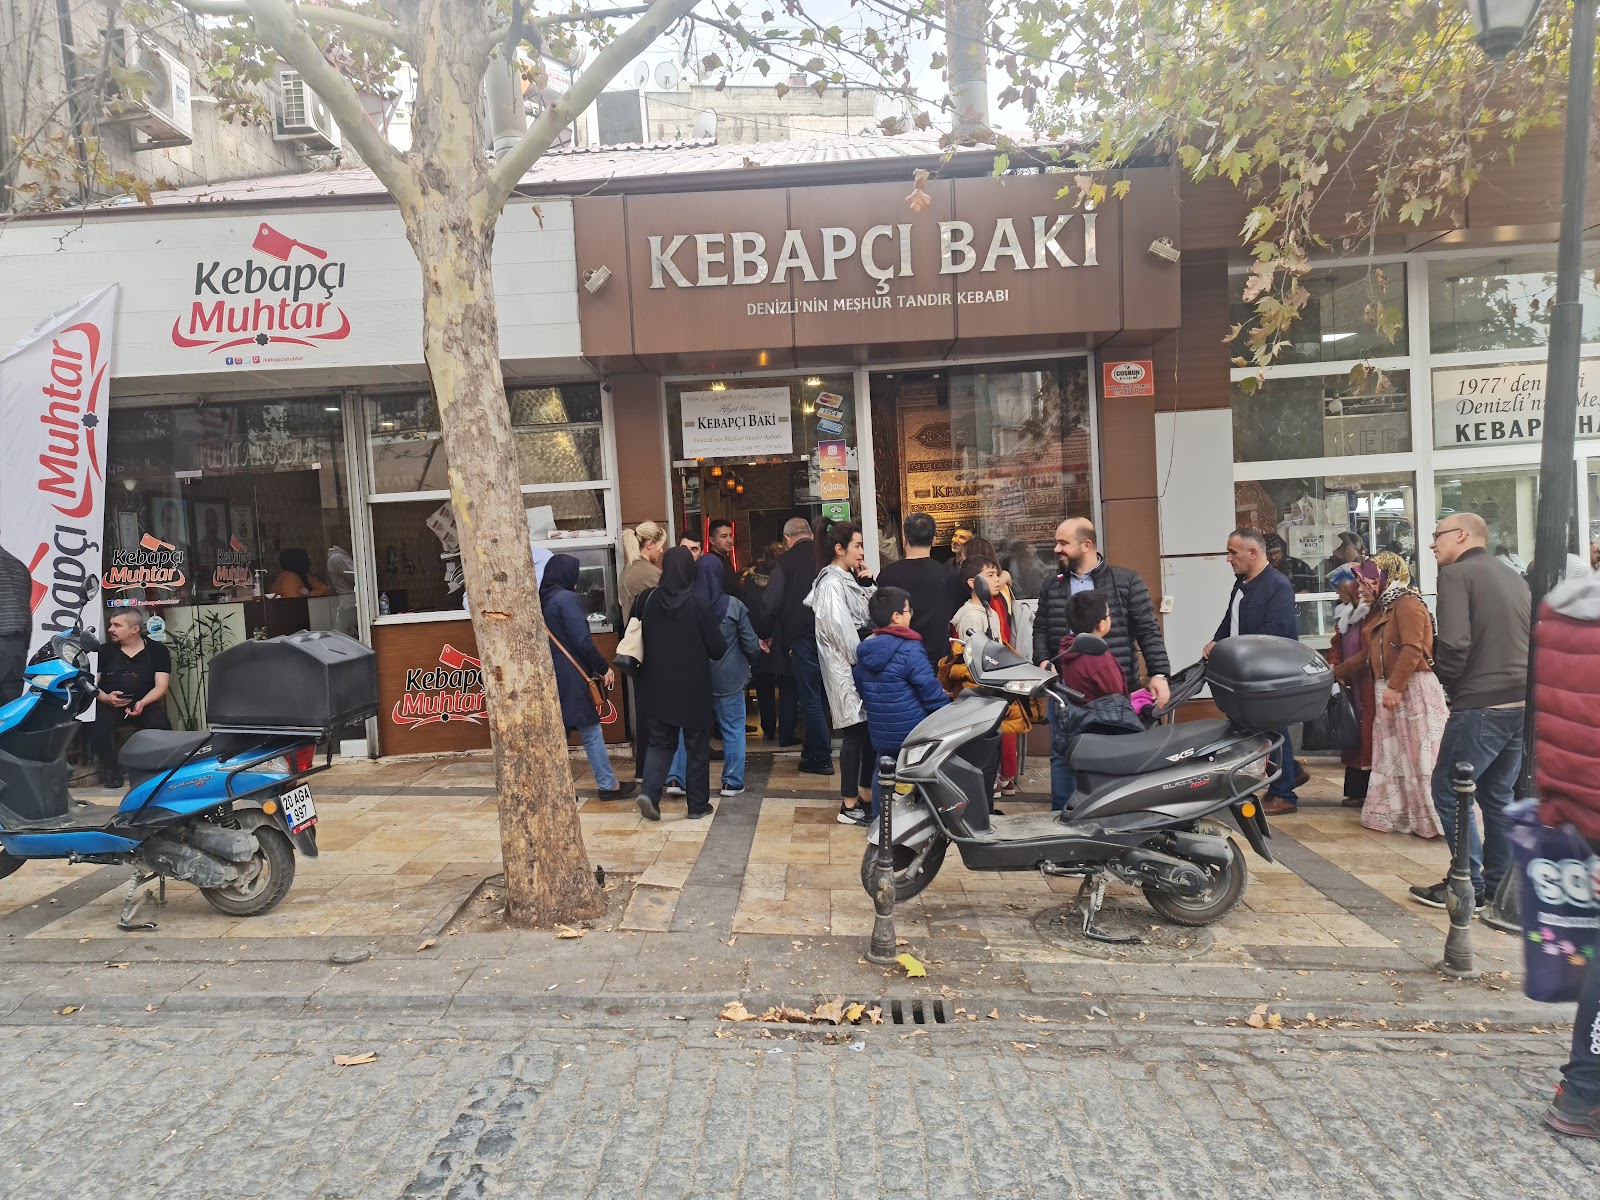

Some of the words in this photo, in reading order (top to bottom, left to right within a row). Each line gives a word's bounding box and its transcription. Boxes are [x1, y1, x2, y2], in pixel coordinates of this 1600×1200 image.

[648, 221, 915, 295] KEBAPÇI
[937, 200, 1100, 275] BAKİ
[194, 259, 346, 302] Kebapçı
[747, 297, 828, 316] DENİZLİ'NİN
[833, 296, 892, 313] MEŞHUR
[896, 293, 951, 308] TANDIR
[957, 289, 1009, 304] KEBABI
[189, 298, 331, 335] Muhtar
[1510, 373, 1542, 392] den
[823, 408, 838, 416] VISA
[1456, 393, 1546, 415] Denizli'n
[38, 338, 83, 499] Muhtar
[698, 416, 746, 430] KEBAPÇI
[749, 413, 776, 427] BAKİ
[1456, 418, 1542, 442] KEBAP
[113, 549, 184, 568] Kebapçı
[41, 524, 99, 634] bapçı
[109, 566, 175, 582] Muhtar
[406, 666, 485, 694] Kebap
[402, 690, 486, 716] Muhtar
[283, 795, 294, 811] 20
[294, 787, 310, 806] AGA
[294, 804, 307, 822] 997
